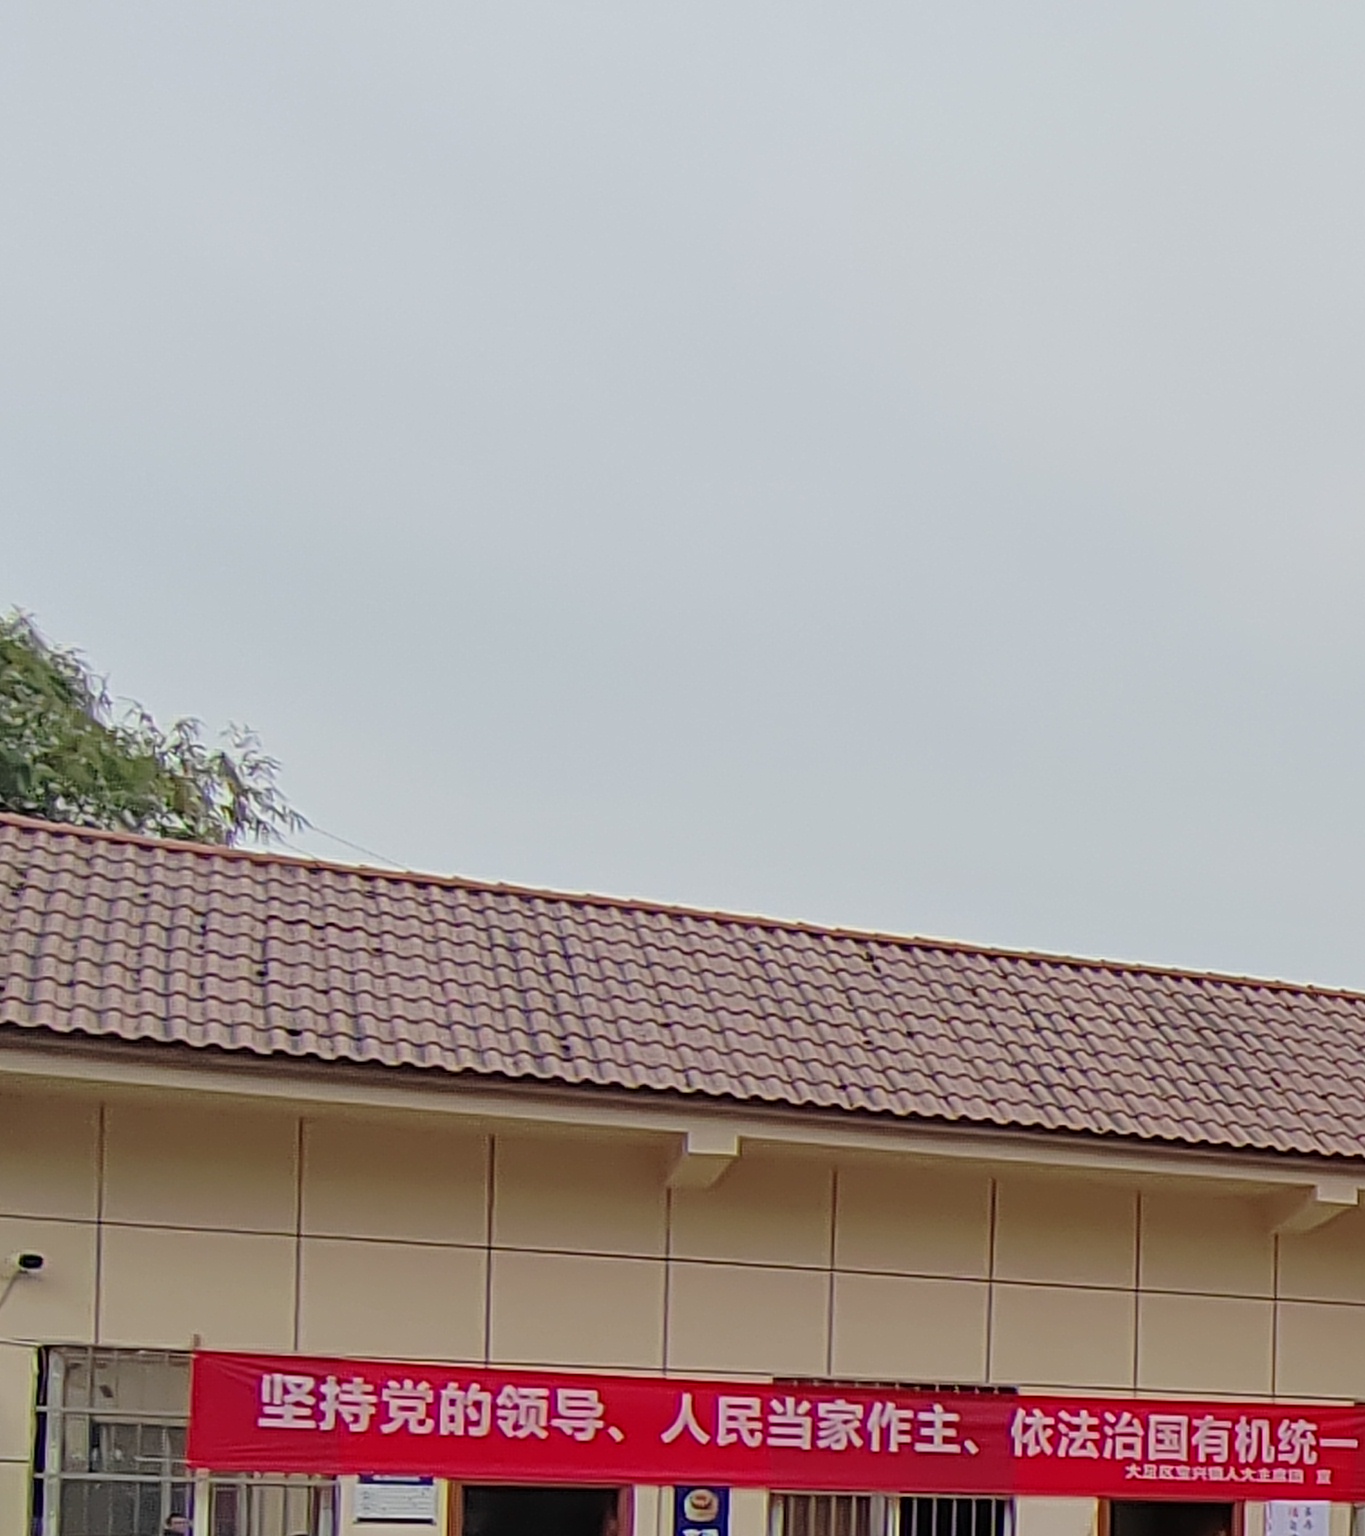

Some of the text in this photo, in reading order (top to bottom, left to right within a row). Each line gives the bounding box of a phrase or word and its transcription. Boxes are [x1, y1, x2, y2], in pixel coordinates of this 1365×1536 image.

[257, 1373, 1359, 1466] 坚持党的领导、人民当家作主、依法治国有机统一
